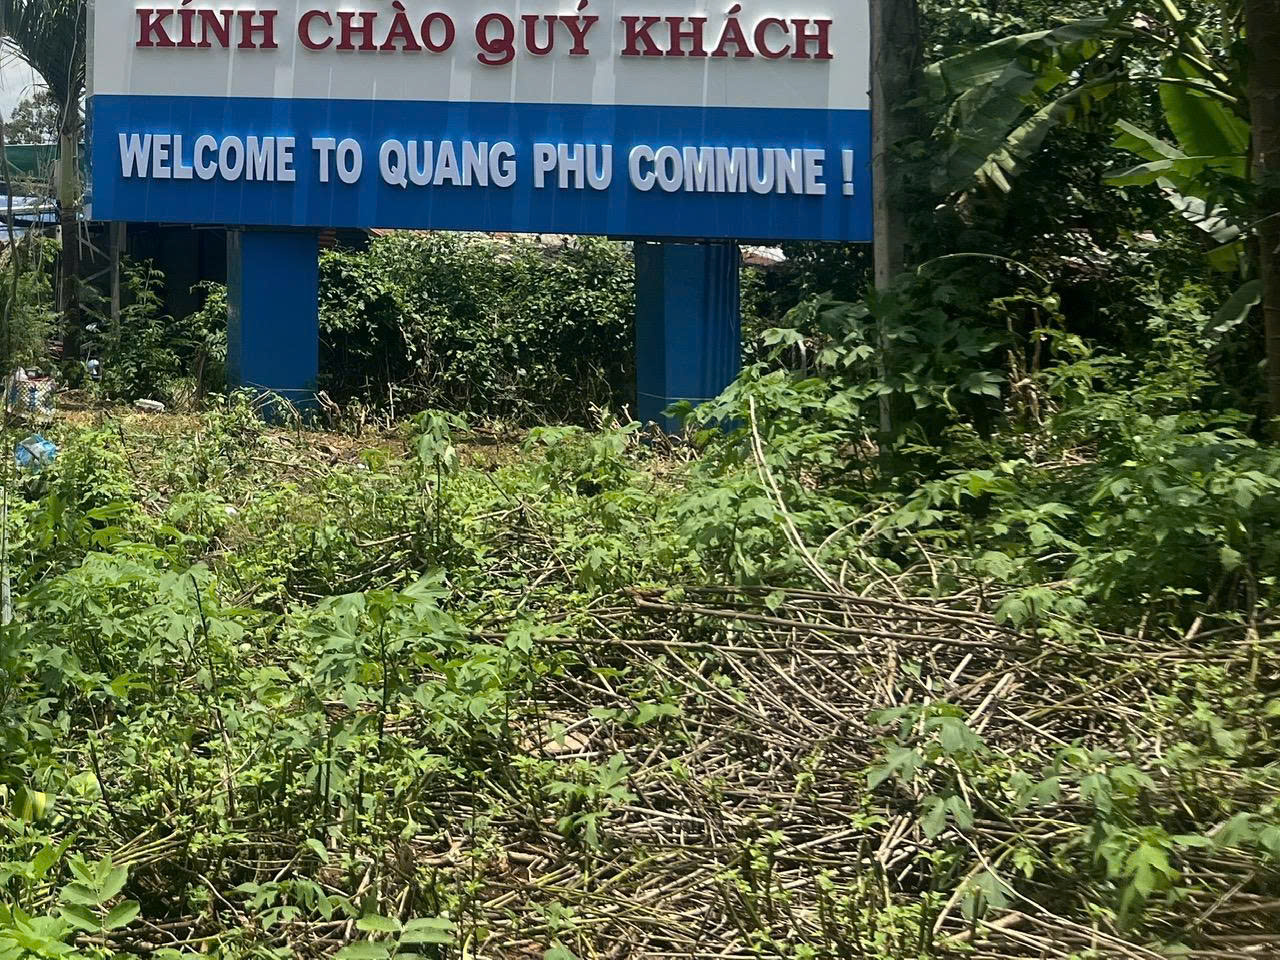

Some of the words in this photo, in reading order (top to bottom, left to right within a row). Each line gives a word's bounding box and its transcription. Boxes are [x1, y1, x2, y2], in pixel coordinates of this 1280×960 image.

[298, 0, 456, 53] CHÀO
[621, 5, 833, 60] KHÁCH
[118, 133, 296, 182] WELCOME
[312, 137, 363, 184] TO
[379, 139, 516, 189] QUANG
[533, 143, 613, 190] PHU
[628, 145, 826, 196] COMMUNE
[842, 150, 854, 196] !
